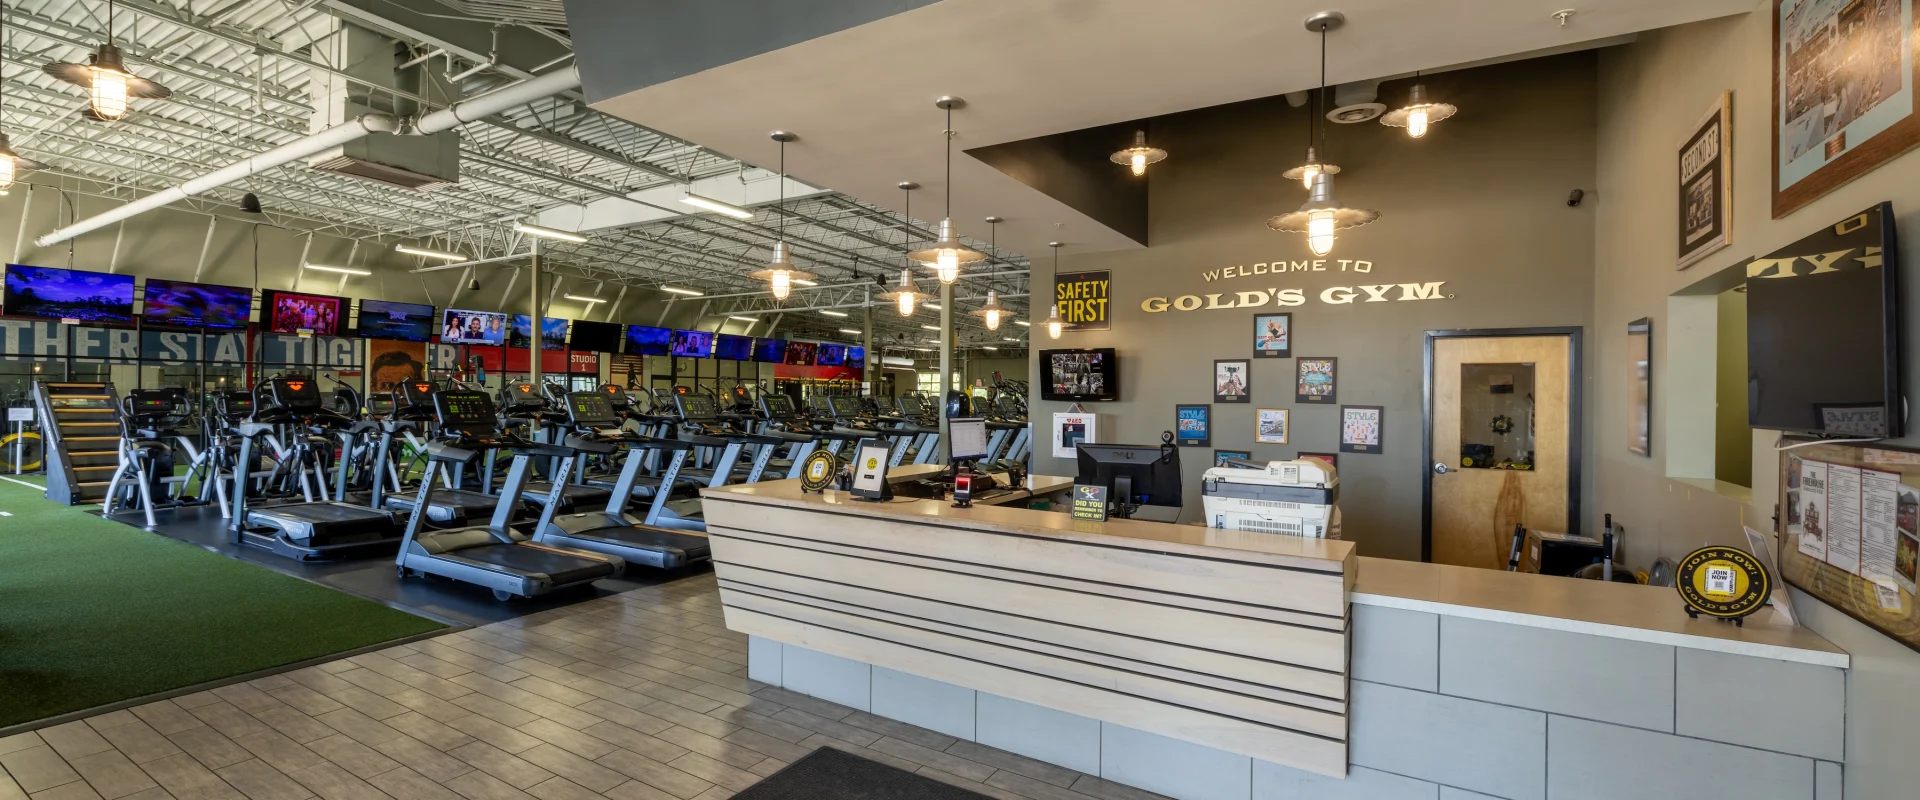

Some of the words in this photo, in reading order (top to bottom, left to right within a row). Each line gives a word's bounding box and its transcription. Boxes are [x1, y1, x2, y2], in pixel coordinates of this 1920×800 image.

[1684, 139, 1706, 179] SECOND
[1708, 130, 1715, 157] ST
[1203, 259, 1327, 282] WELCOME
[1337, 259, 1373, 274] TO
[1057, 280, 1109, 299] SAFETY
[1141, 288, 1307, 313] GOLD'S
[1057, 298, 1108, 322] FIRST
[159, 331, 263, 368] STAY
[571, 354, 597, 364] STUDIO
[581, 363, 586, 372] 1
[1301, 361, 1331, 372] STYLE
[1179, 409, 1206, 420] STYLE
[1346, 411, 1376, 421] STYLE
[663, 451, 684, 492] MATRIX
[752, 447, 772, 483] MATRIX
[412, 470, 432, 522] MATRIX
[550, 461, 572, 507] MATRIX
[1687, 551, 1718, 571] JOIN
[1723, 551, 1758, 575] NOW!
[1685, 586, 1728, 611] GOLD'S
[1731, 591, 1758, 610] GYM
